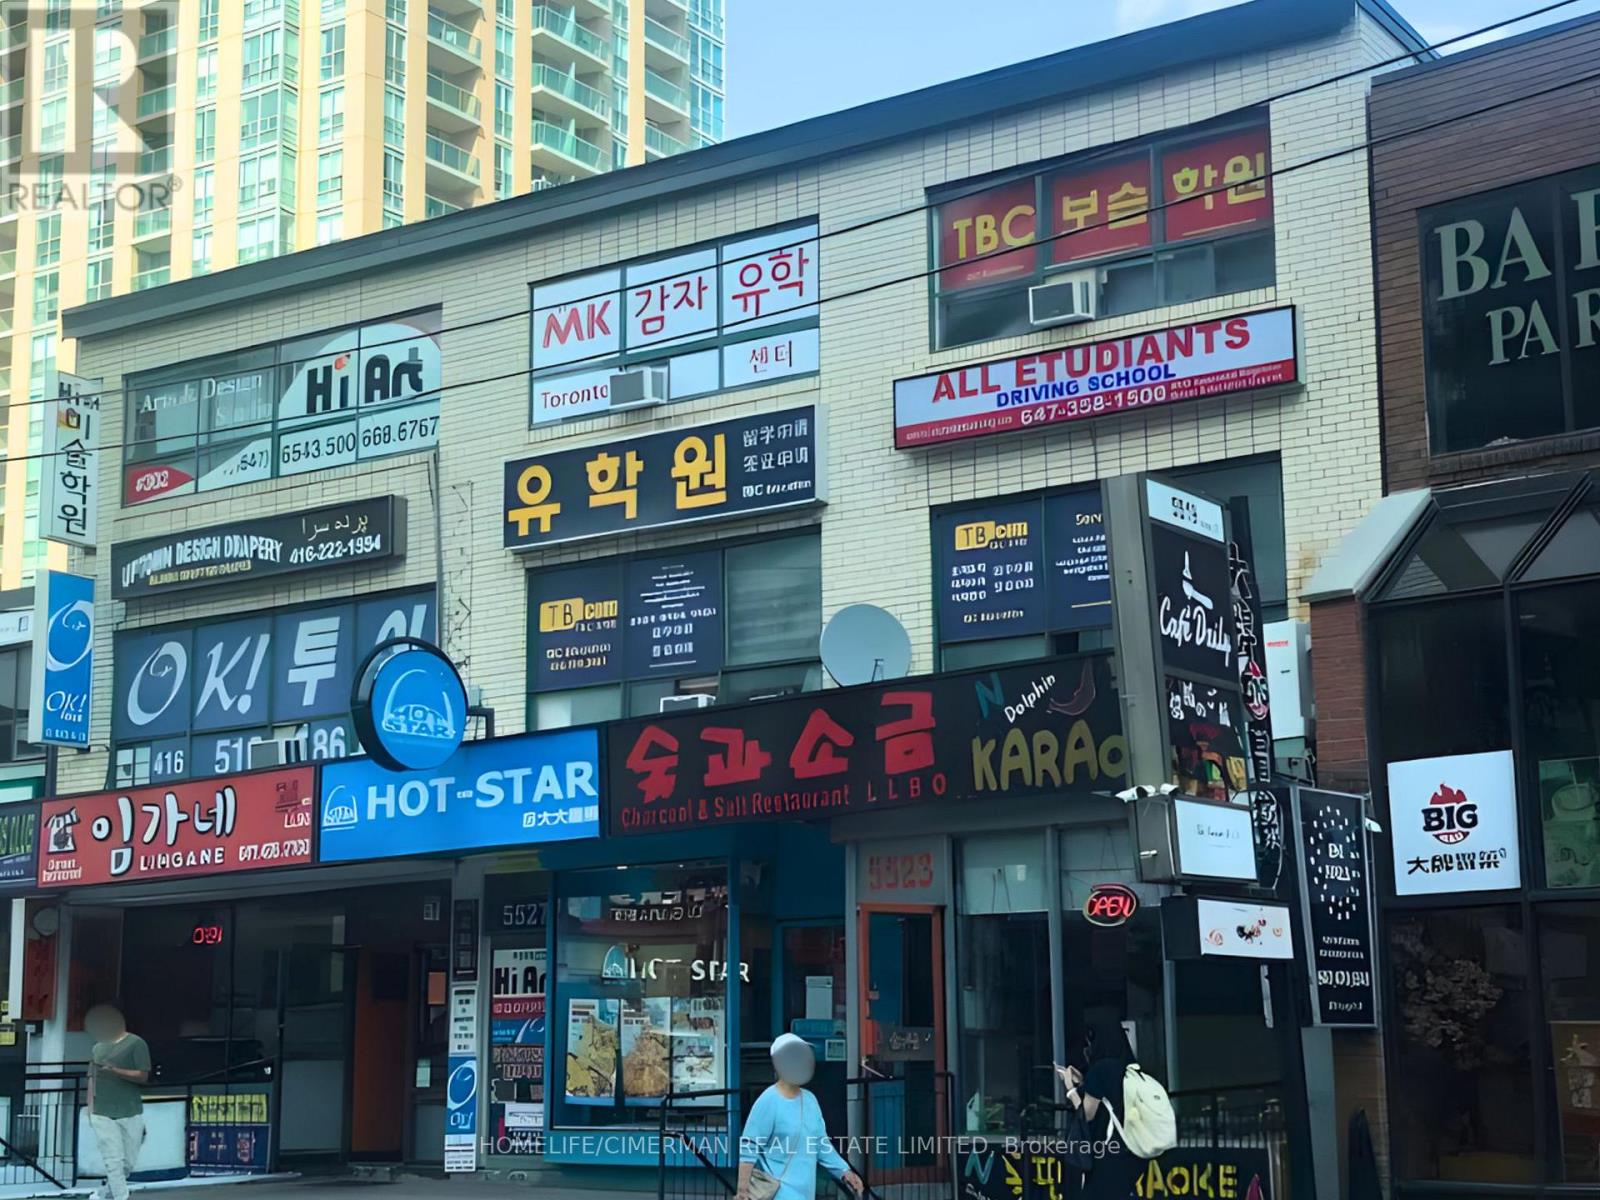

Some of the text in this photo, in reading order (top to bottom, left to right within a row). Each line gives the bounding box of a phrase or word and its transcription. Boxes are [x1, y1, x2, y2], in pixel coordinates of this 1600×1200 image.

[953, 205, 1035, 259] TBC
[542, 247, 810, 348] MK 감자 유학
[932, 366, 1001, 403] ALL
[1014, 318, 1251, 387] ETUDIANTS
[996, 379, 1080, 409] DRIVING
[1087, 363, 1177, 391] SCHOOL
[91, 785, 238, 877] 임가네
[1421, 803, 1479, 832] BIG
